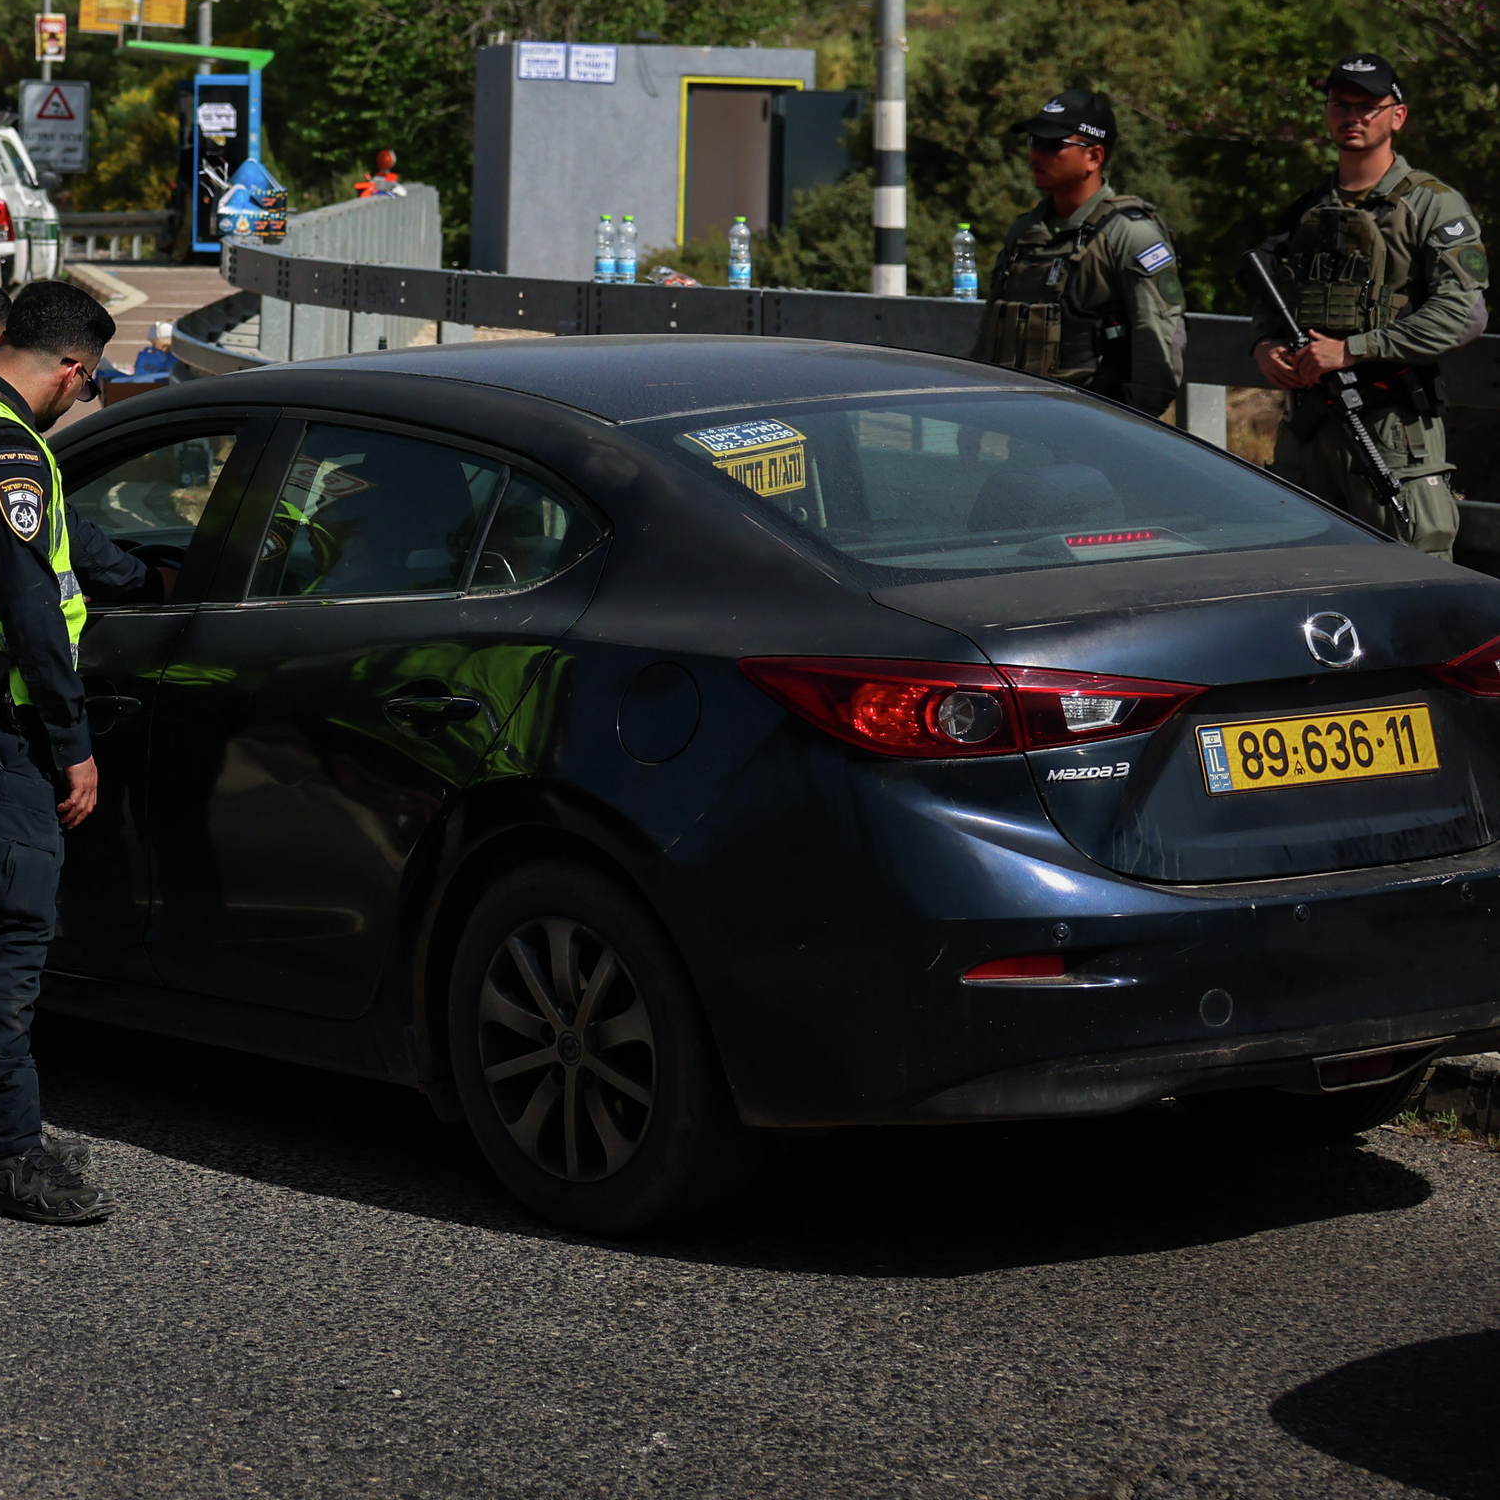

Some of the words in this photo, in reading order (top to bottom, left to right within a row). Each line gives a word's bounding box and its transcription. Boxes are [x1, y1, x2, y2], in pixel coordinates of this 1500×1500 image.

[741, 422, 783, 436] מאיר
[698, 432, 742, 446] ביטון
[710, 429, 794, 451] 052-2678236
[18, 453, 39, 462] משטרת
[1208, 749, 1225, 772] IL
